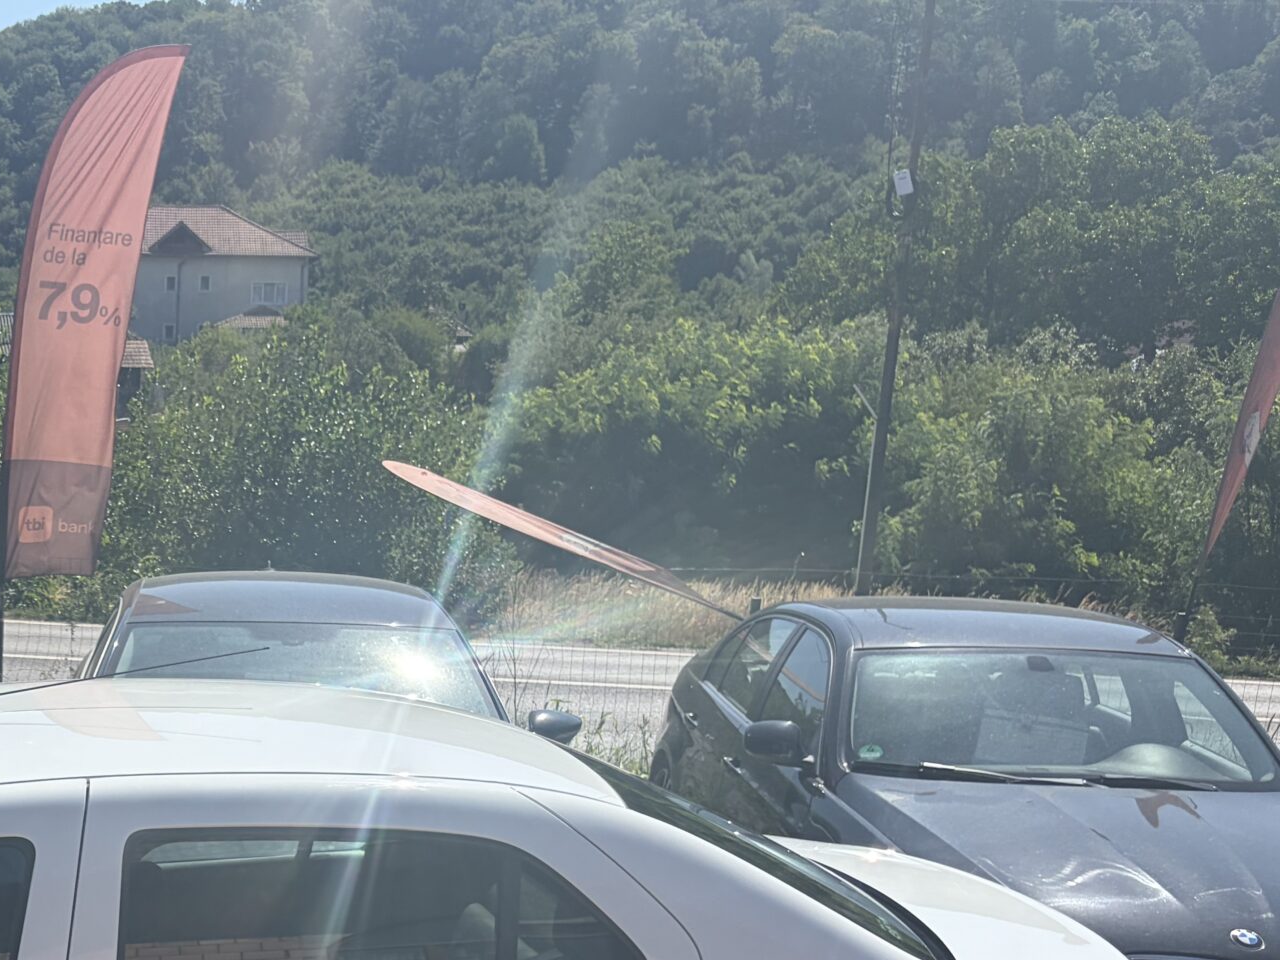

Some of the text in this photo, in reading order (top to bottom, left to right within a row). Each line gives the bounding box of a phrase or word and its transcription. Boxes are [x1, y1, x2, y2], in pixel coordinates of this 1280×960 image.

[43, 246, 87, 266] de la
[38, 280, 121, 330] 7,9%
[24, 517, 47, 532] tbi
